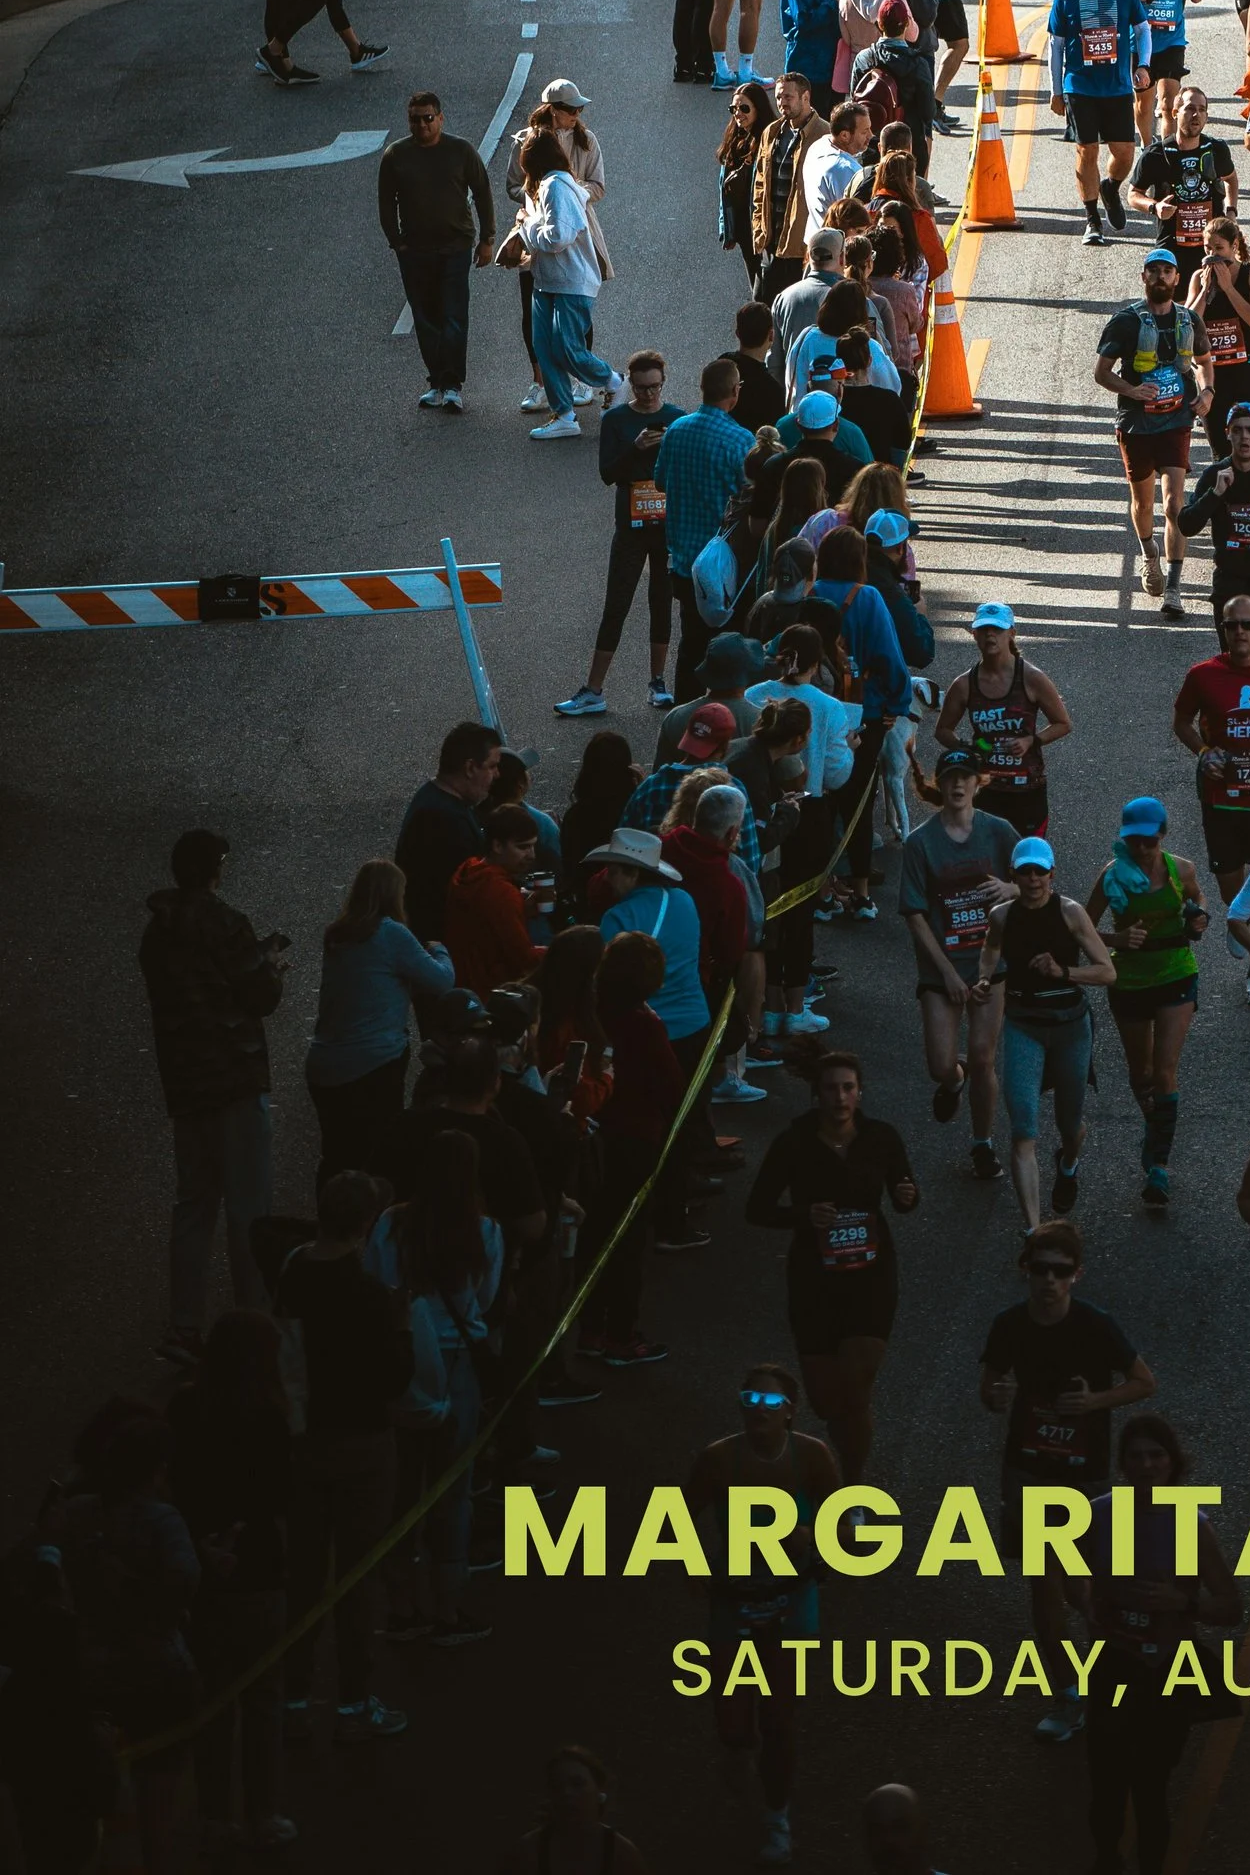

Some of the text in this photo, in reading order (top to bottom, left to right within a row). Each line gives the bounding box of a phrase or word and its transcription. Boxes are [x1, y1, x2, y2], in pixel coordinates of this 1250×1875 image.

[1148, 10, 1174, 18] 20681
[1088, 43, 1112, 52] 3435
[1182, 219, 1207, 228] 3345
[1212, 335, 1237, 346] 2759
[636, 500, 666, 511] 31687
[973, 707, 1006, 721] EAST
[978, 718, 1024, 734] NASTY
[988, 754, 1023, 765] 4599
[952, 909, 985, 923] 5885
[829, 1227, 867, 1243] 2298
[1037, 1425, 1075, 1441] 4717
